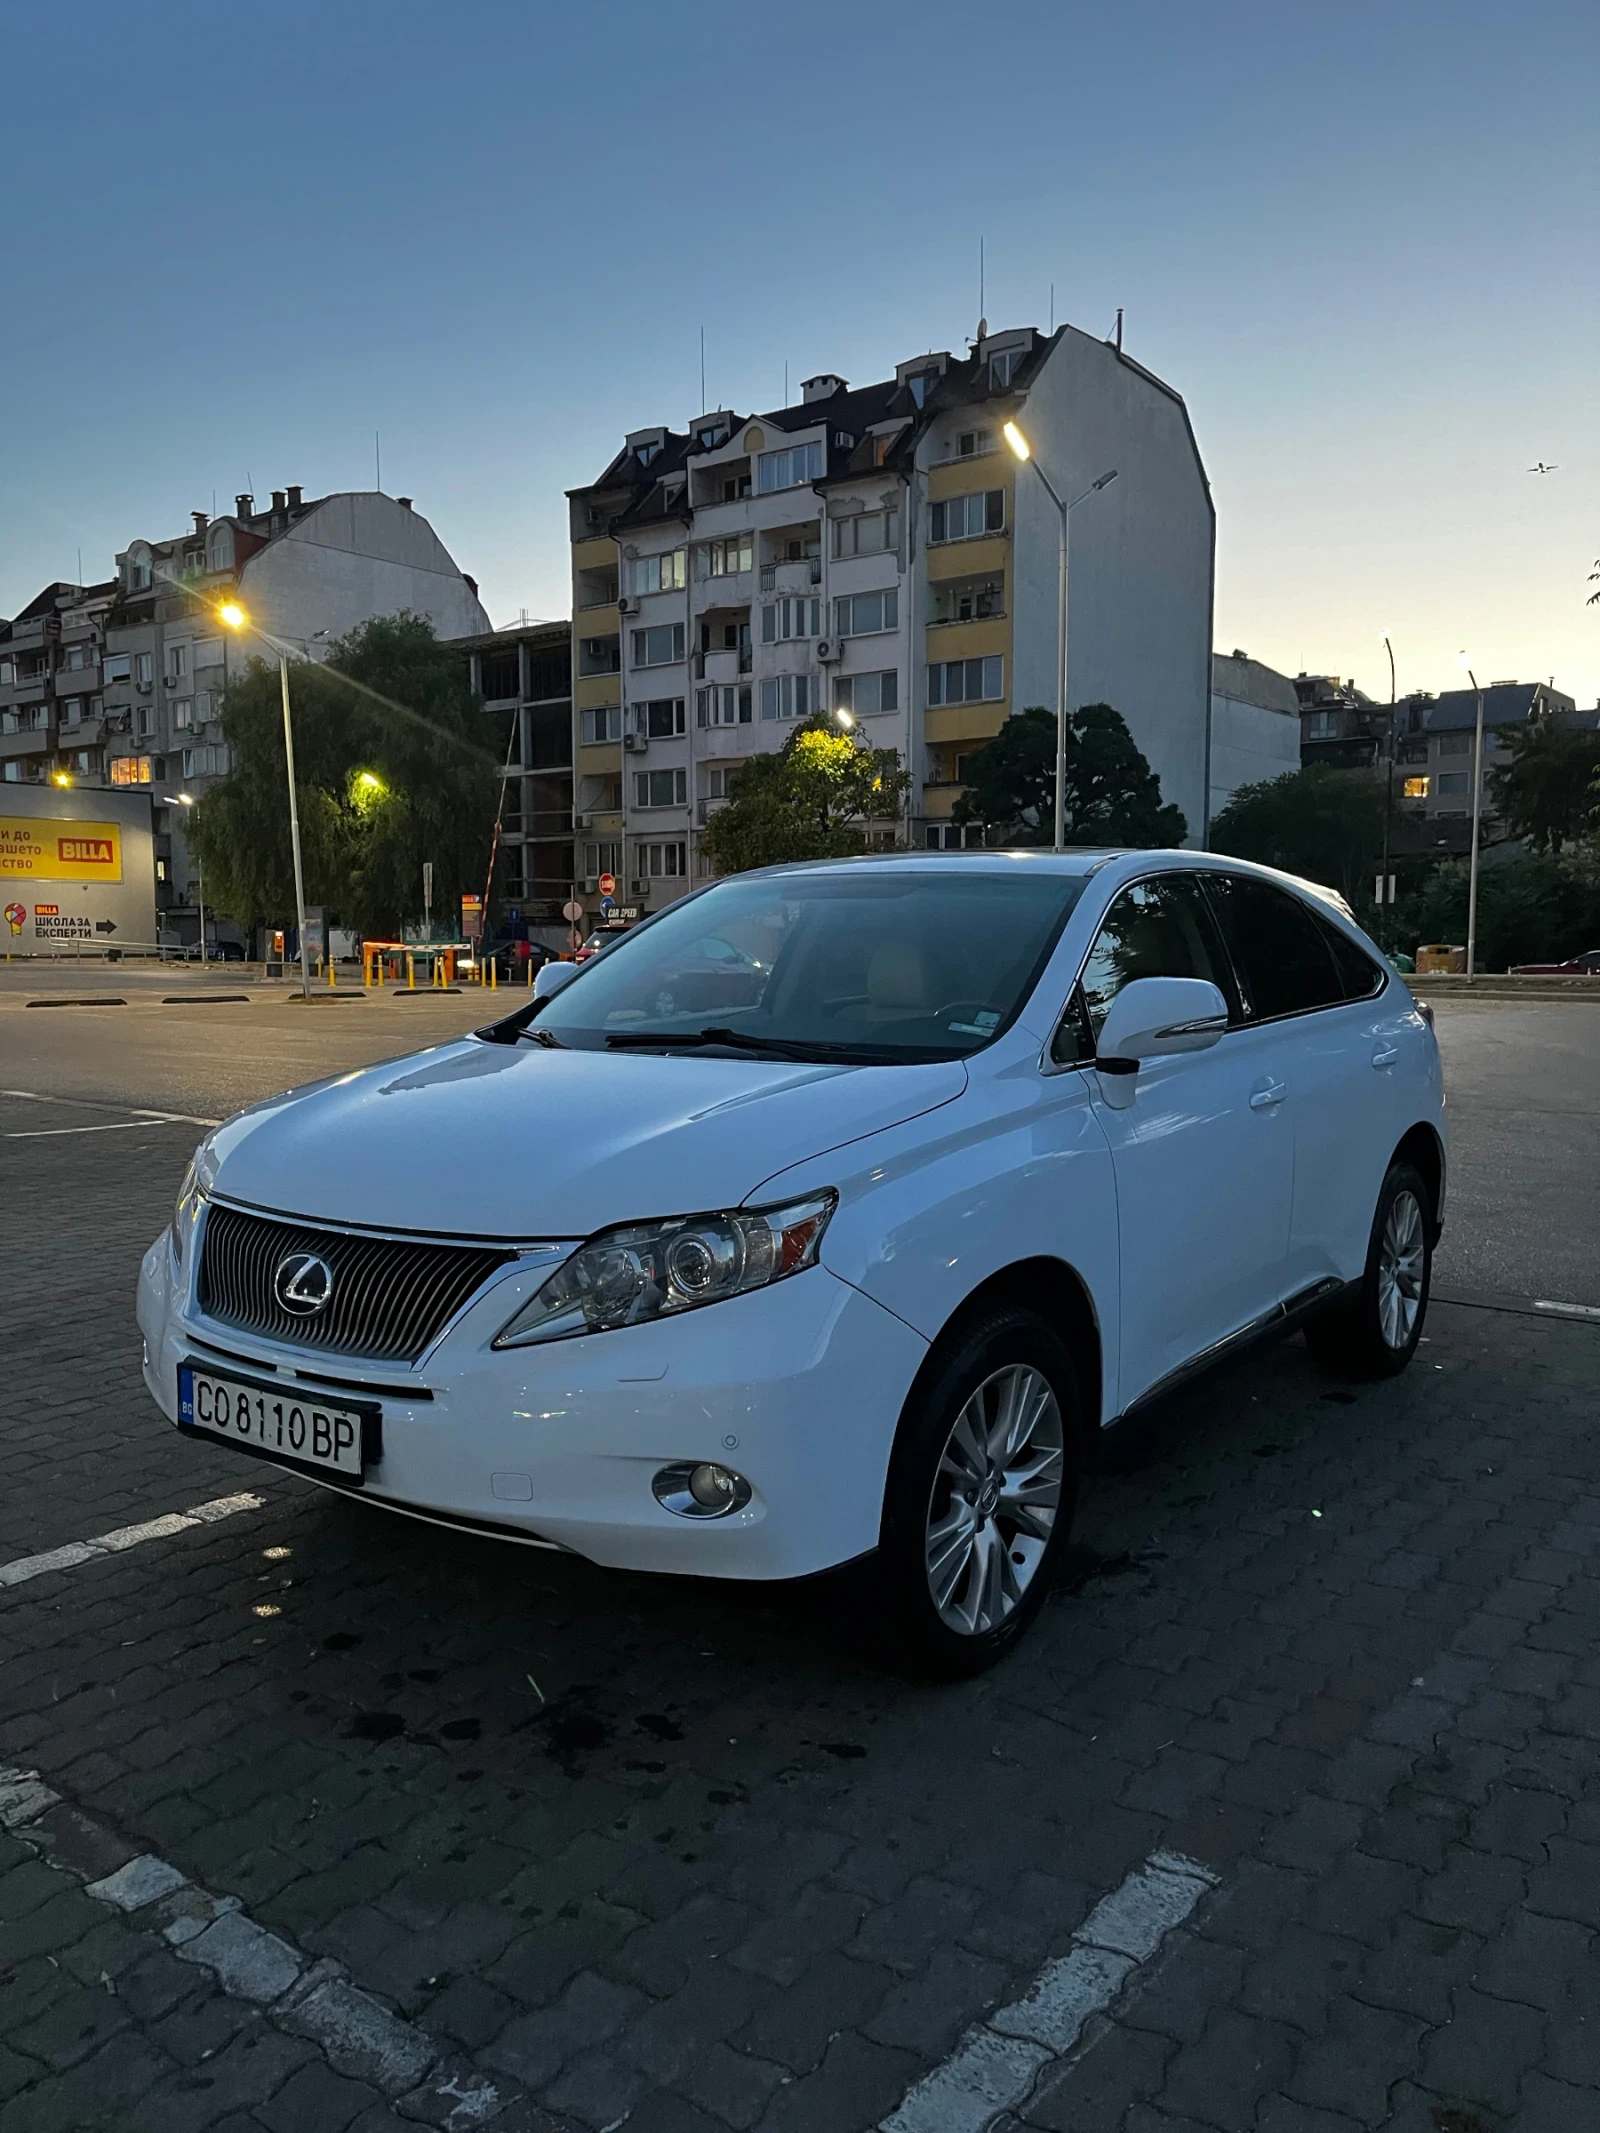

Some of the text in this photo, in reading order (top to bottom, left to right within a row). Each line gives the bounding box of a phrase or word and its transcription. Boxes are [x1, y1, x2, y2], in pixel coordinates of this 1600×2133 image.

[13, 831, 31, 842] до
[62, 842, 110, 860] BILLA
[0, 859, 33, 869] ство
[36, 906, 58, 914] BILLA
[35, 917, 91, 927] ШКОЛА ЗА
[35, 927, 92, 938] ЕКСПЕРТИ
[182, 1401, 193, 1416] BG
